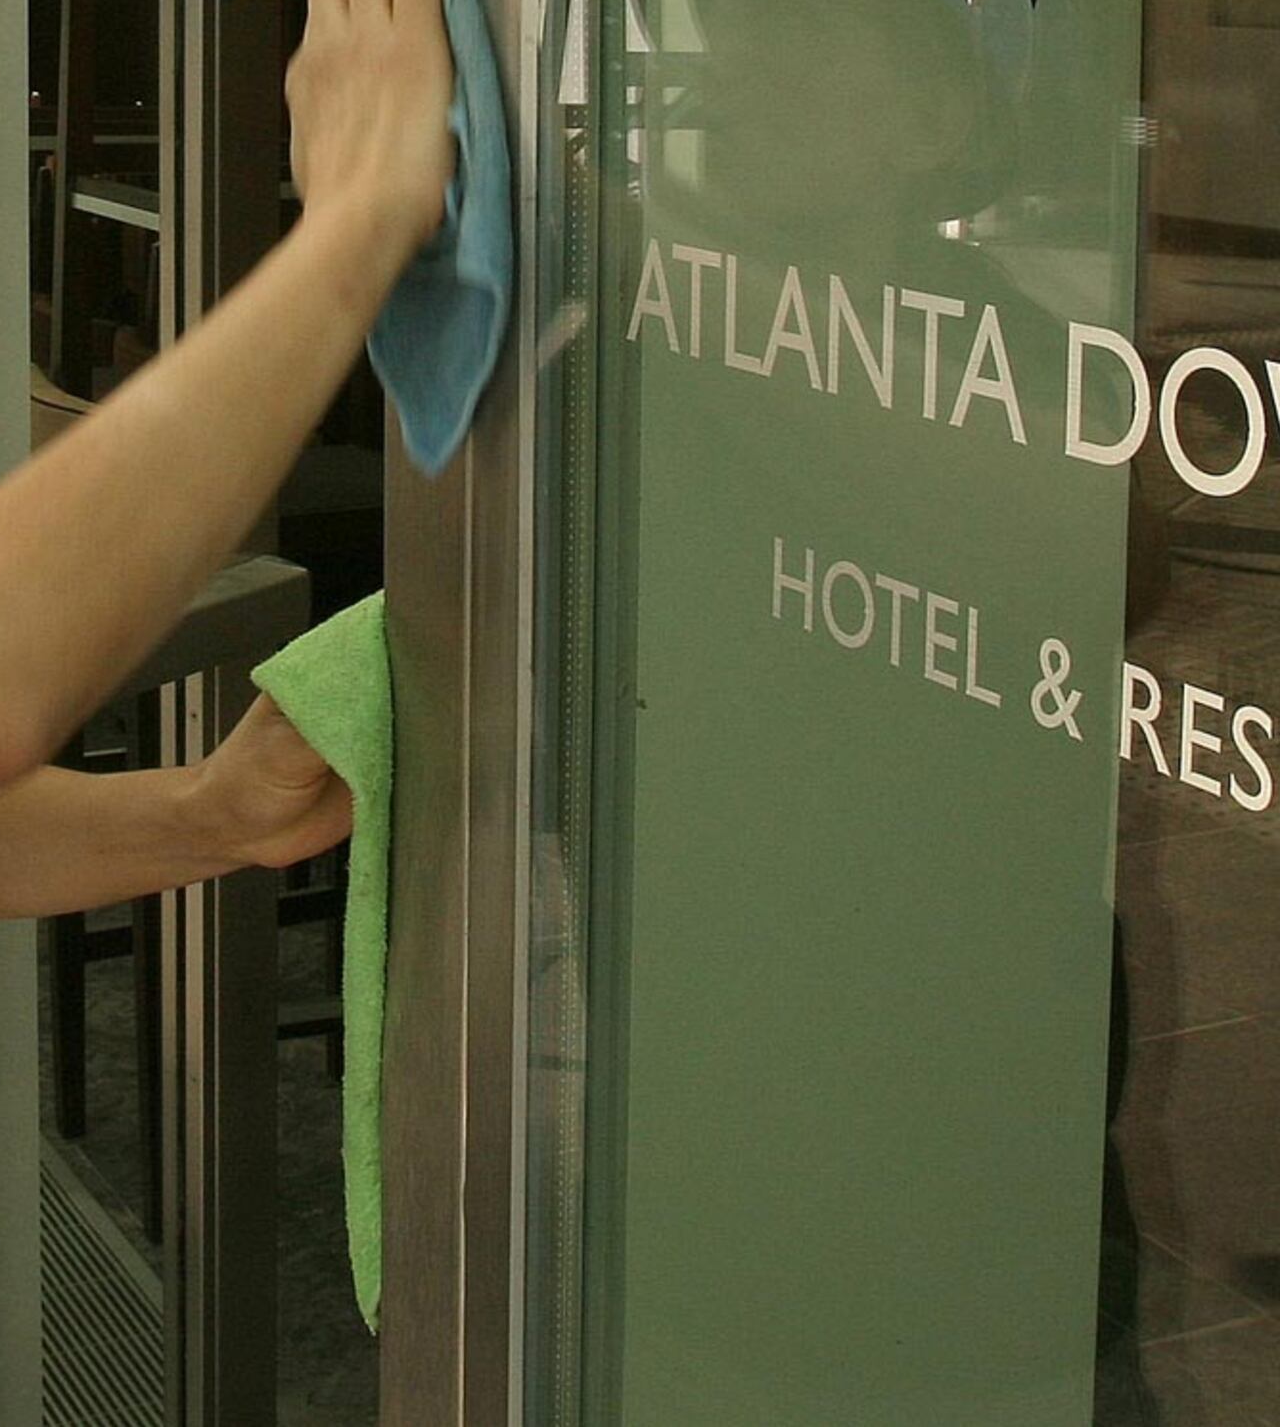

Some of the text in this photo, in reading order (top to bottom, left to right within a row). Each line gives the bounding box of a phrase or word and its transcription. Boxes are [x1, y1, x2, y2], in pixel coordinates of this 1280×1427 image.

[626, 238, 1027, 445] ATLANTA
[773, 537, 1001, 709] HOTEL
[1030, 637, 1084, 741] &
